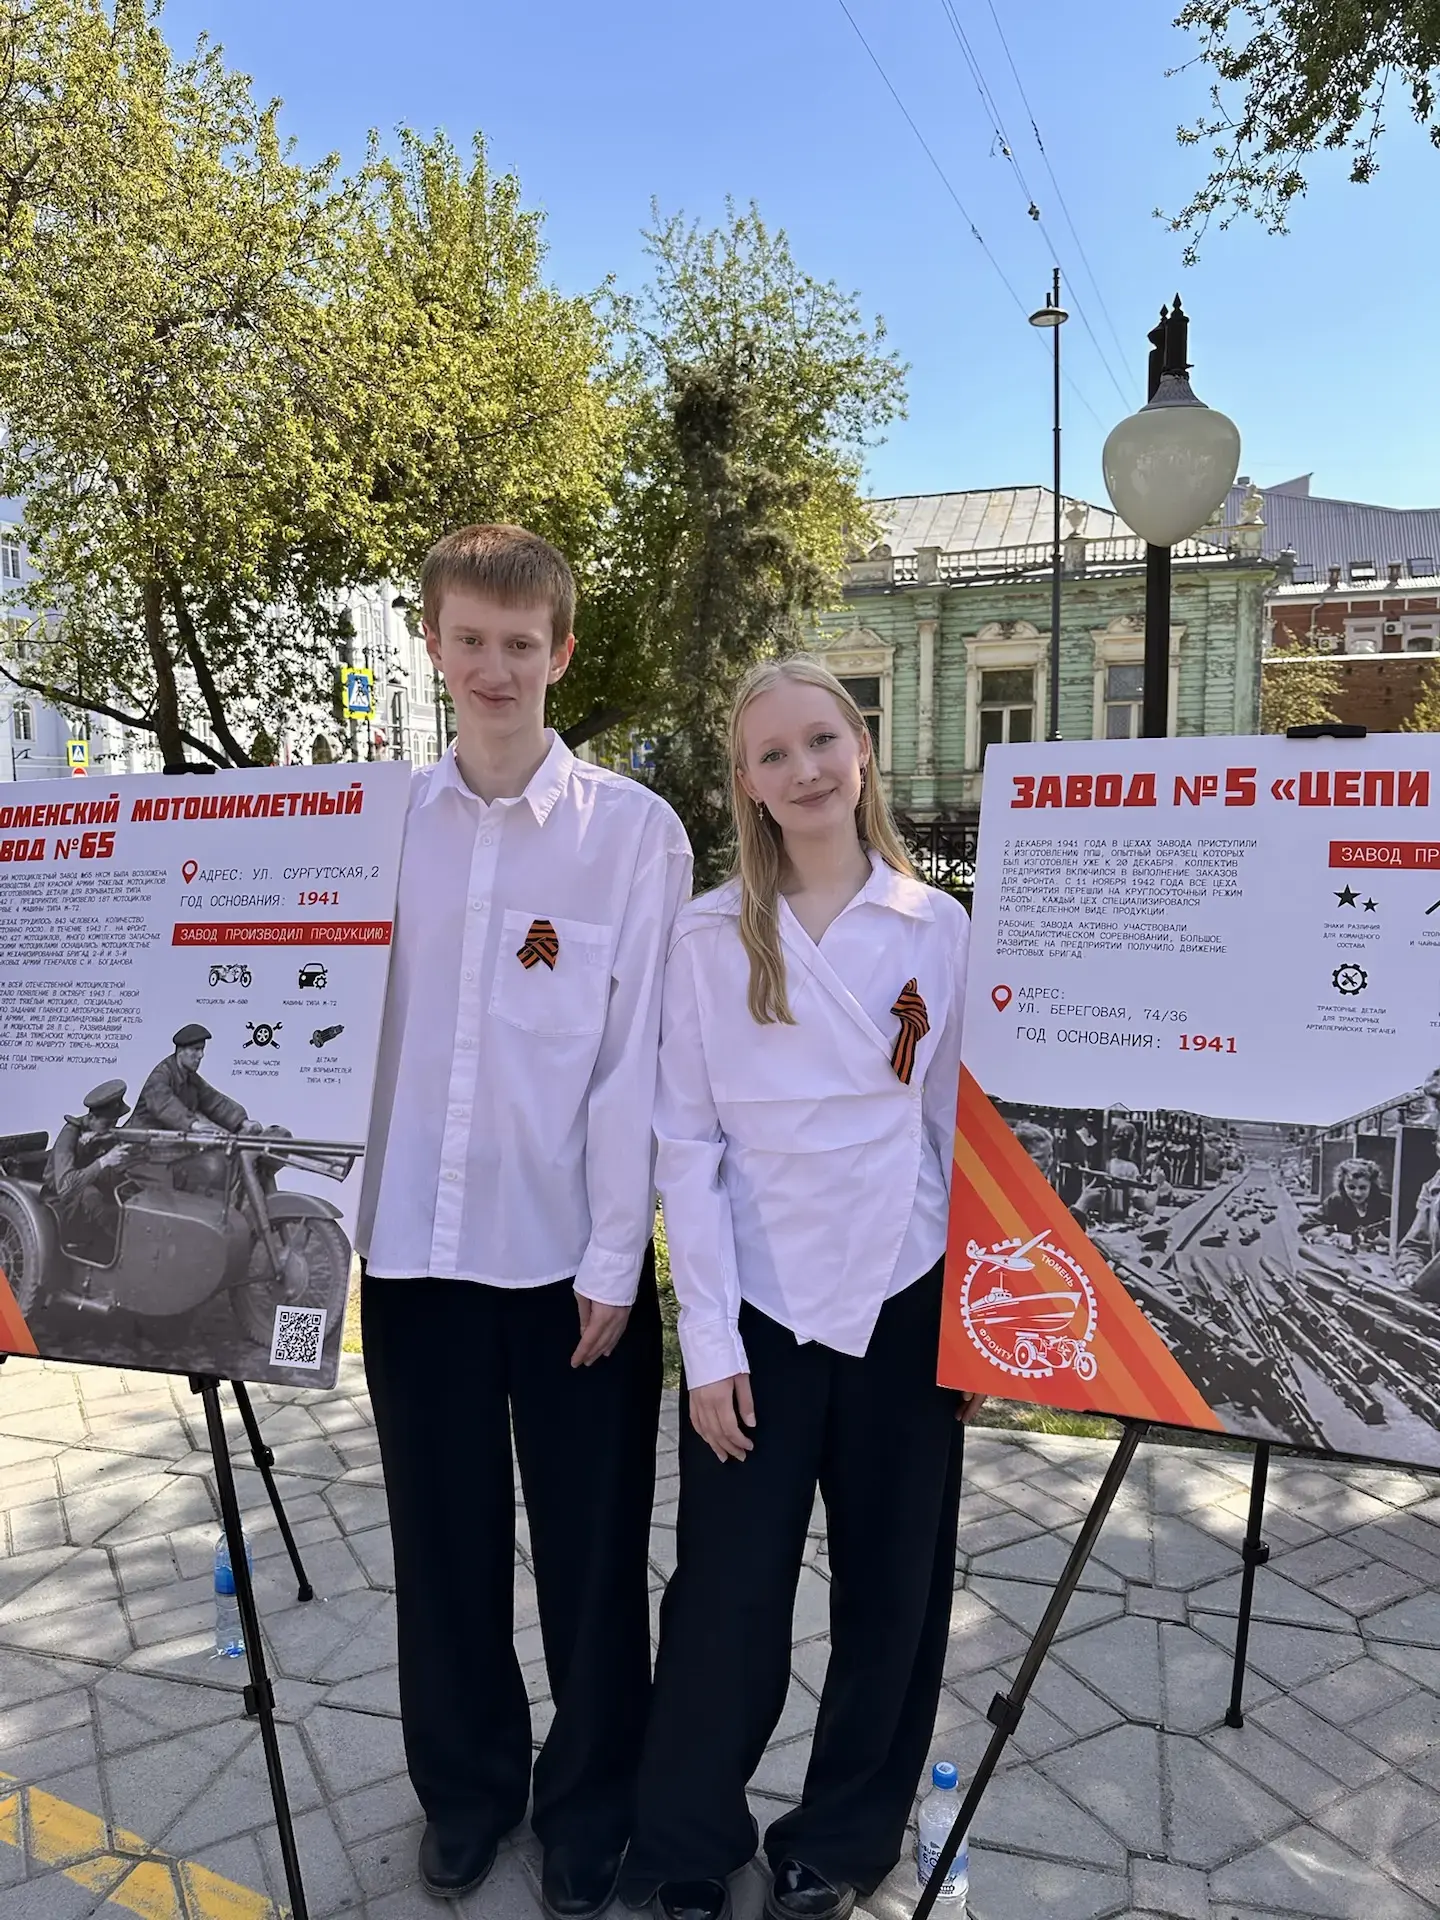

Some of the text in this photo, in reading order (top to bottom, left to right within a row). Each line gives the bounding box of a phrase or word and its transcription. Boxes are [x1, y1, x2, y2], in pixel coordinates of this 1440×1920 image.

[1010, 768, 1430, 808] ЗАВОД №5 «ЦЕПИ
[131, 782, 364, 823] МОТОЦИКЛЕТНЫЙ
[54, 831, 116, 860] №65
[1004, 840, 1010, 848] 2
[1084, 840, 1107, 848] ГОДА
[1123, 840, 1152, 848] ЦЕХАХ
[1157, 840, 1192, 848] ЗАВОДА
[1156, 849, 1198, 857] ОБРАЗЕЦ
[1203, 849, 1245, 857] КОТОРЫХ
[1341, 847, 1402, 865] ЗАВОД
[199, 867, 244, 882] АДРЕС:
[252, 867, 273, 881] УЛ.
[1002, 867, 1061, 875] ПРЕДПРИЯТИЯ
[1196, 869, 1238, 877] ЗАКАЗОВ
[1002, 877, 1018, 885] ДЛЯ
[1065, 877, 1071, 885] С
[1189, 878, 1207, 886] ВСЕ
[1213, 879, 1237, 887] ЦЕХА
[1001, 886, 1060, 894] ПРЕДПРИЯТИЯ
[1064, 887, 1103, 895] ПЕРЕШЛИ
[1125, 888, 1207, 896] КРУГЛОСУТОЧНЫЙ
[180, 890, 340, 909] ГОД ОСНОВАНИЯ: 1941
[1080, 897, 1097, 905] ЦЕХ
[1102, 897, 1201, 906] СПЕЦИАЛИЗИРОВАЛСЯ
[1015, 905, 1080, 914] ОПРЕДЕЛЕННОМ
[1085, 906, 1108, 914] ВИДЕ
[998, 920, 1187, 932] РАБОЧИЕ ЗАВОДА АКТИВНО УЧАСТВОВАЛИ
[180, 926, 390, 942] ЗАВОД ПРОИЗВОДИЛ ПРОДУКЦИЮ:
[1008, 930, 1095, 939] СОЦИАЛИСТИЧЕСКОМ
[1180, 935, 1222, 943] БОЛЬШОЕ
[997, 939, 1039, 947] РАЗВИТИЕ
[1061, 941, 1122, 949] ПРЕДПРИЯТИИ
[1127, 942, 1175, 951] ПОЛУЧИЛО
[1179, 944, 1227, 953] ДВИЖЕНИЕ
[997, 948, 1044, 956] ФРОНТОВЫХ
[1018, 987, 1065, 1001] АДРЕС:
[1018, 1002, 1188, 1022] УЛ. БЕРЕГОВАЯ, 74/36
[1016, 1026, 1238, 1053] ГОД ОСНОВАНИЯ: 1941
[1040, 1253, 1074, 1288] ТЮМЕНЬ
[979, 1328, 1014, 1361] ФРОНТУ
